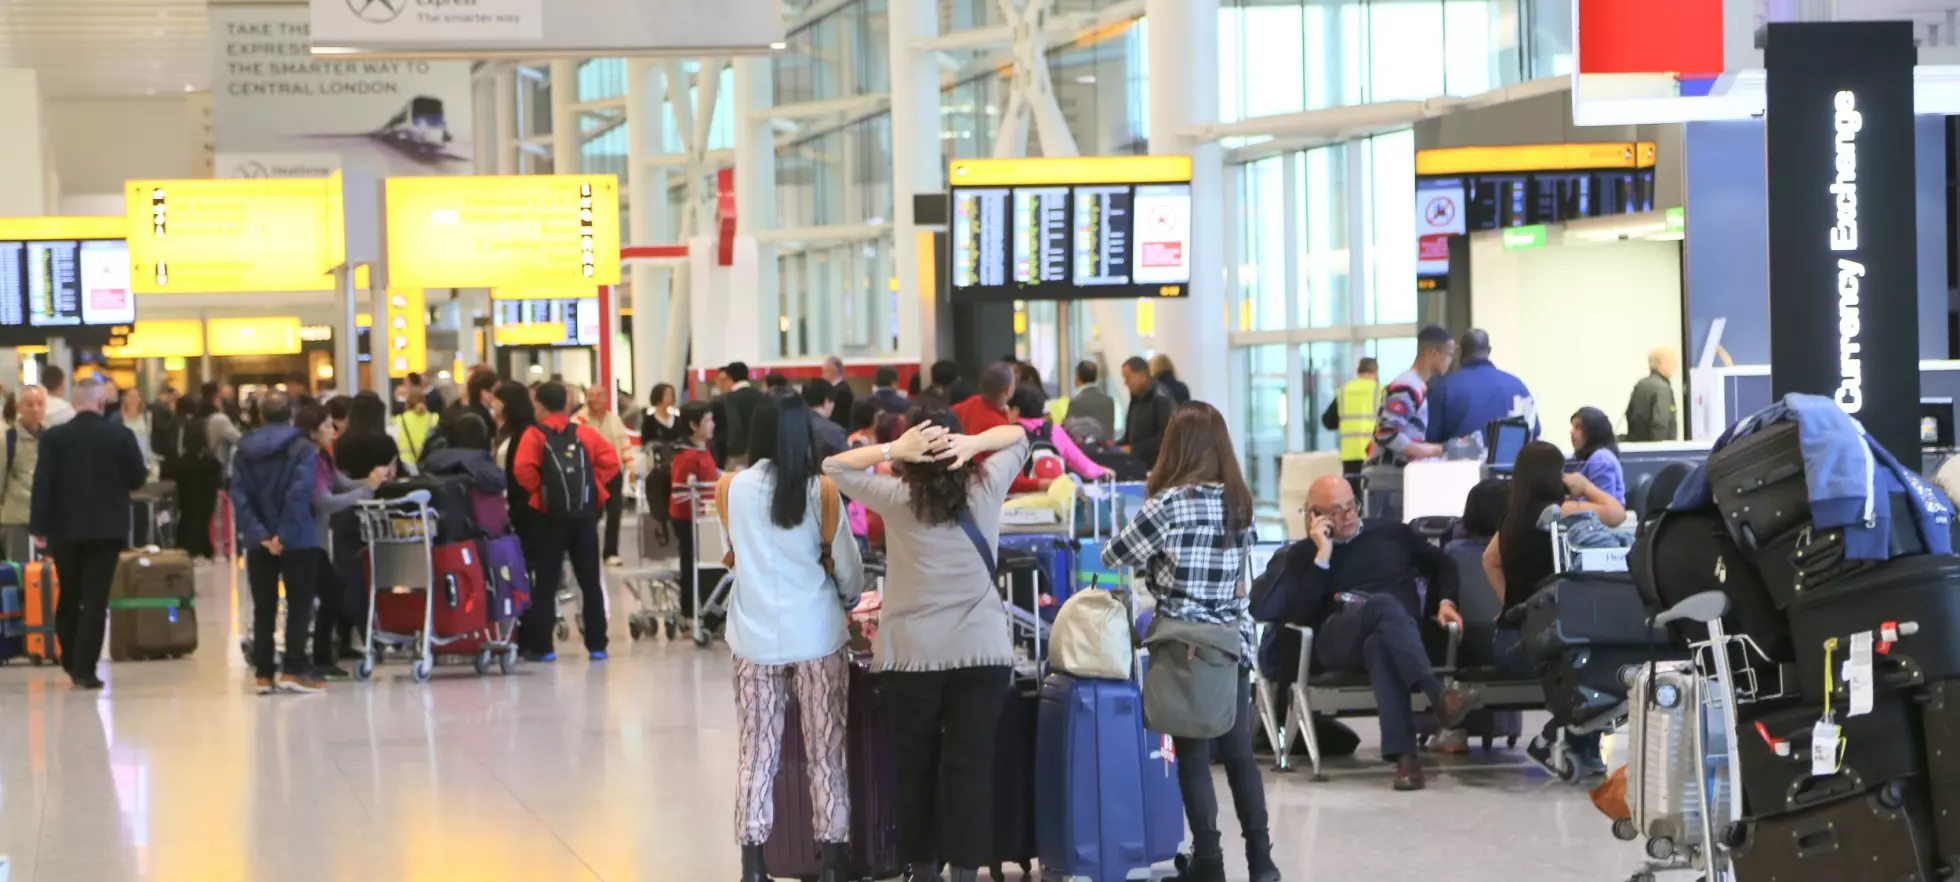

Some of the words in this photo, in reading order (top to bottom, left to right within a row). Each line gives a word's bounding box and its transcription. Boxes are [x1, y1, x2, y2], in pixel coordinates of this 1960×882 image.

[416, 11, 439, 23] The
[444, 12, 492, 23] smarter
[227, 23, 272, 36] TAKE
[228, 62, 263, 75] THE
[269, 62, 357, 75] SMARTER
[363, 61, 399, 75] WAY
[406, 61, 430, 74] TO
[227, 81, 313, 95] CENTRAL
[1829, 90, 1863, 251] Exchange
[1834, 258, 1865, 413] Currency
